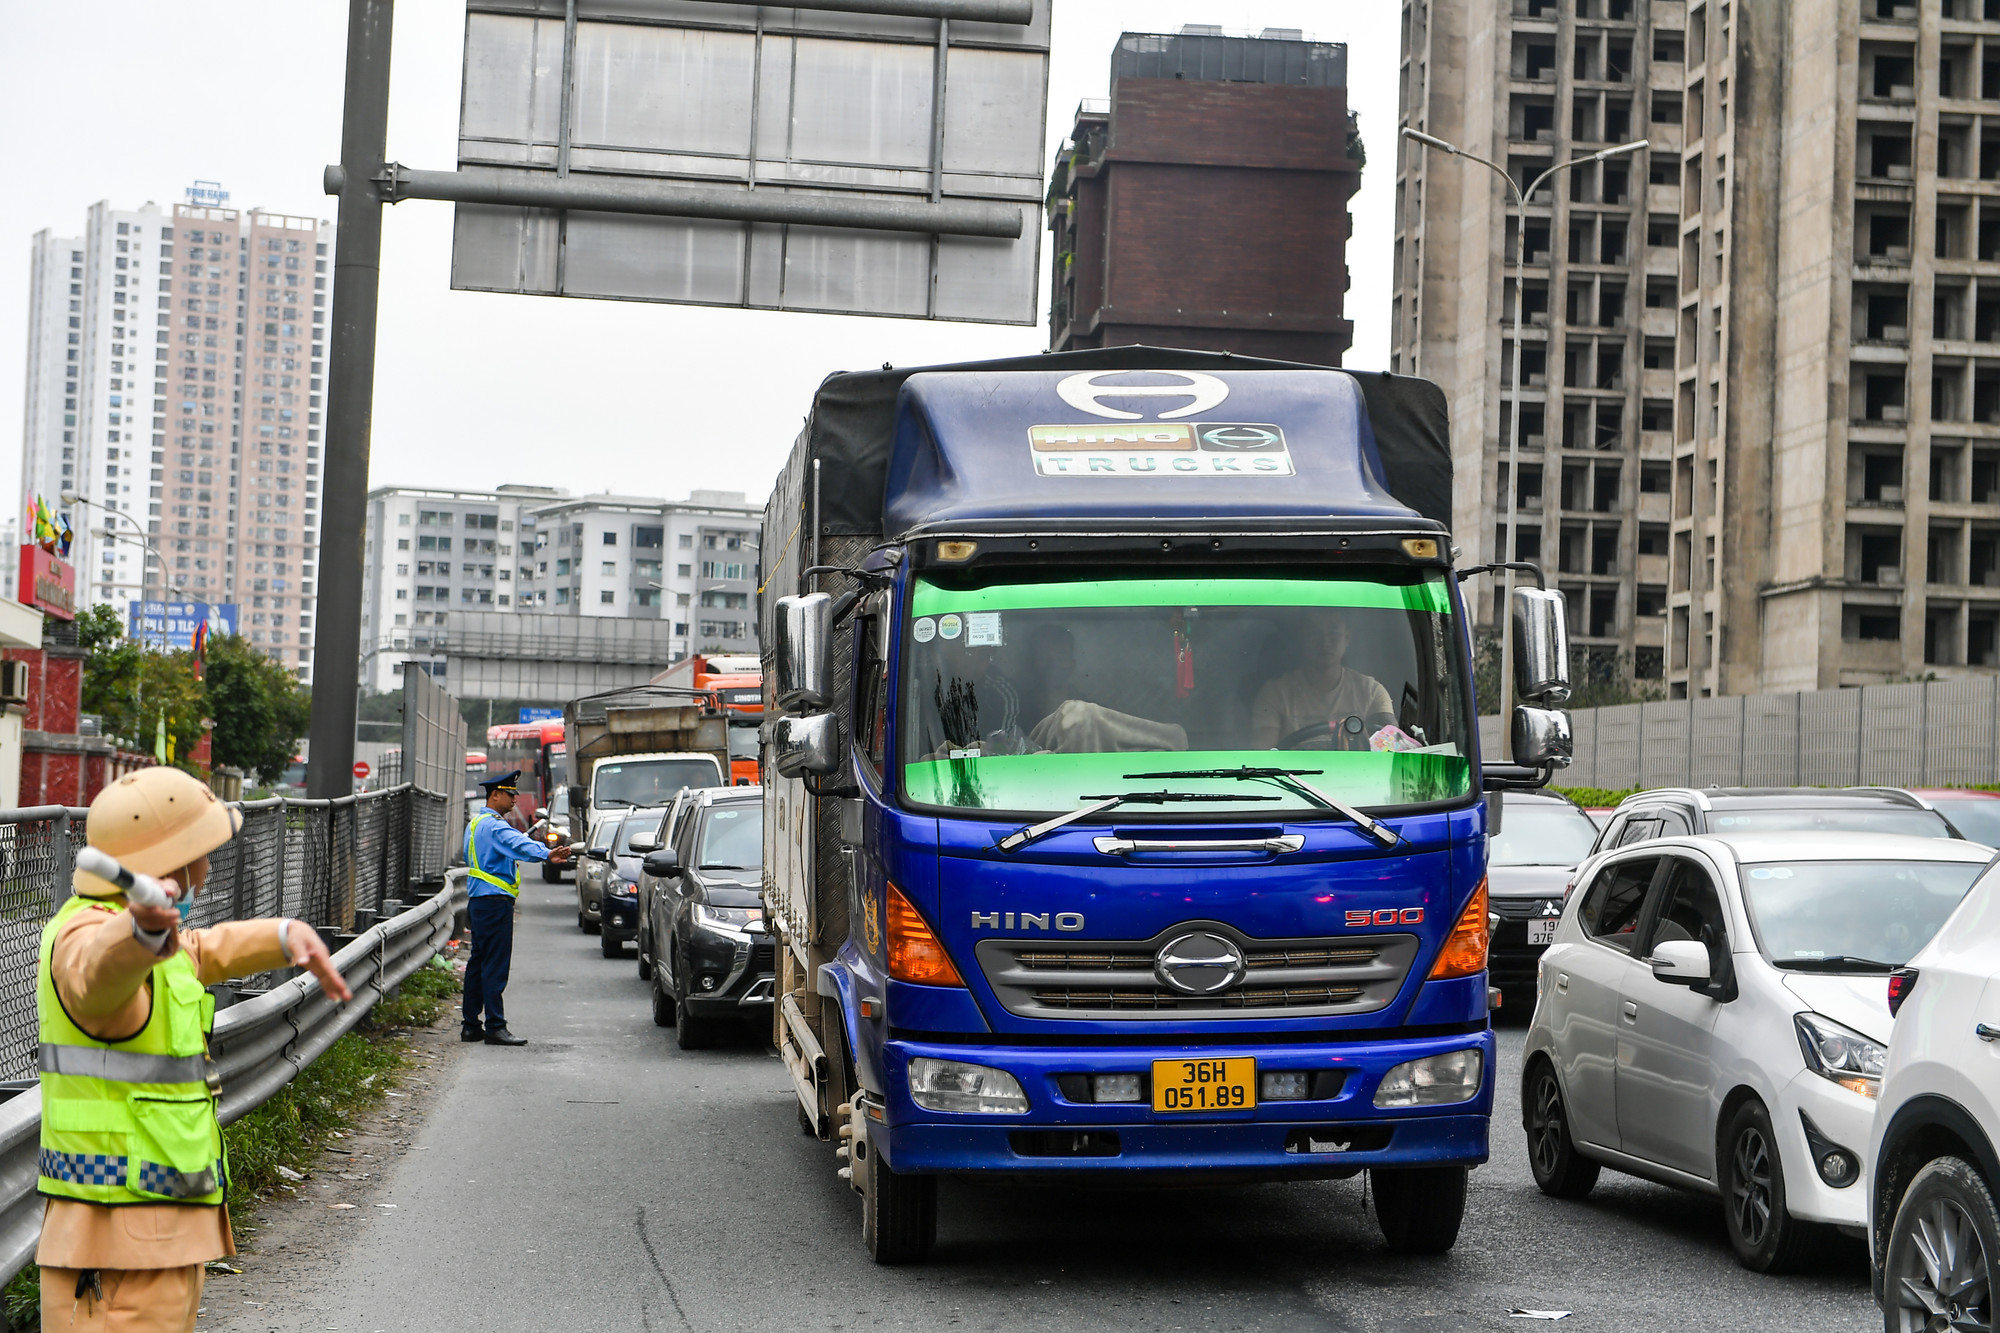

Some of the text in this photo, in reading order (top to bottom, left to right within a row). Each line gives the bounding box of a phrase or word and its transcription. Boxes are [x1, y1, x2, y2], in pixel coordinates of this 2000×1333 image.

[1044, 432, 1183, 444] HINO
[1048, 457, 1281, 472] TRUCKS
[177, 619, 195, 633] TLC
[971, 911, 1085, 932] HINO
[1345, 907, 1425, 927] 500
[1182, 1061, 1226, 1084] 36H
[1164, 1085, 1245, 1109] 051.89
